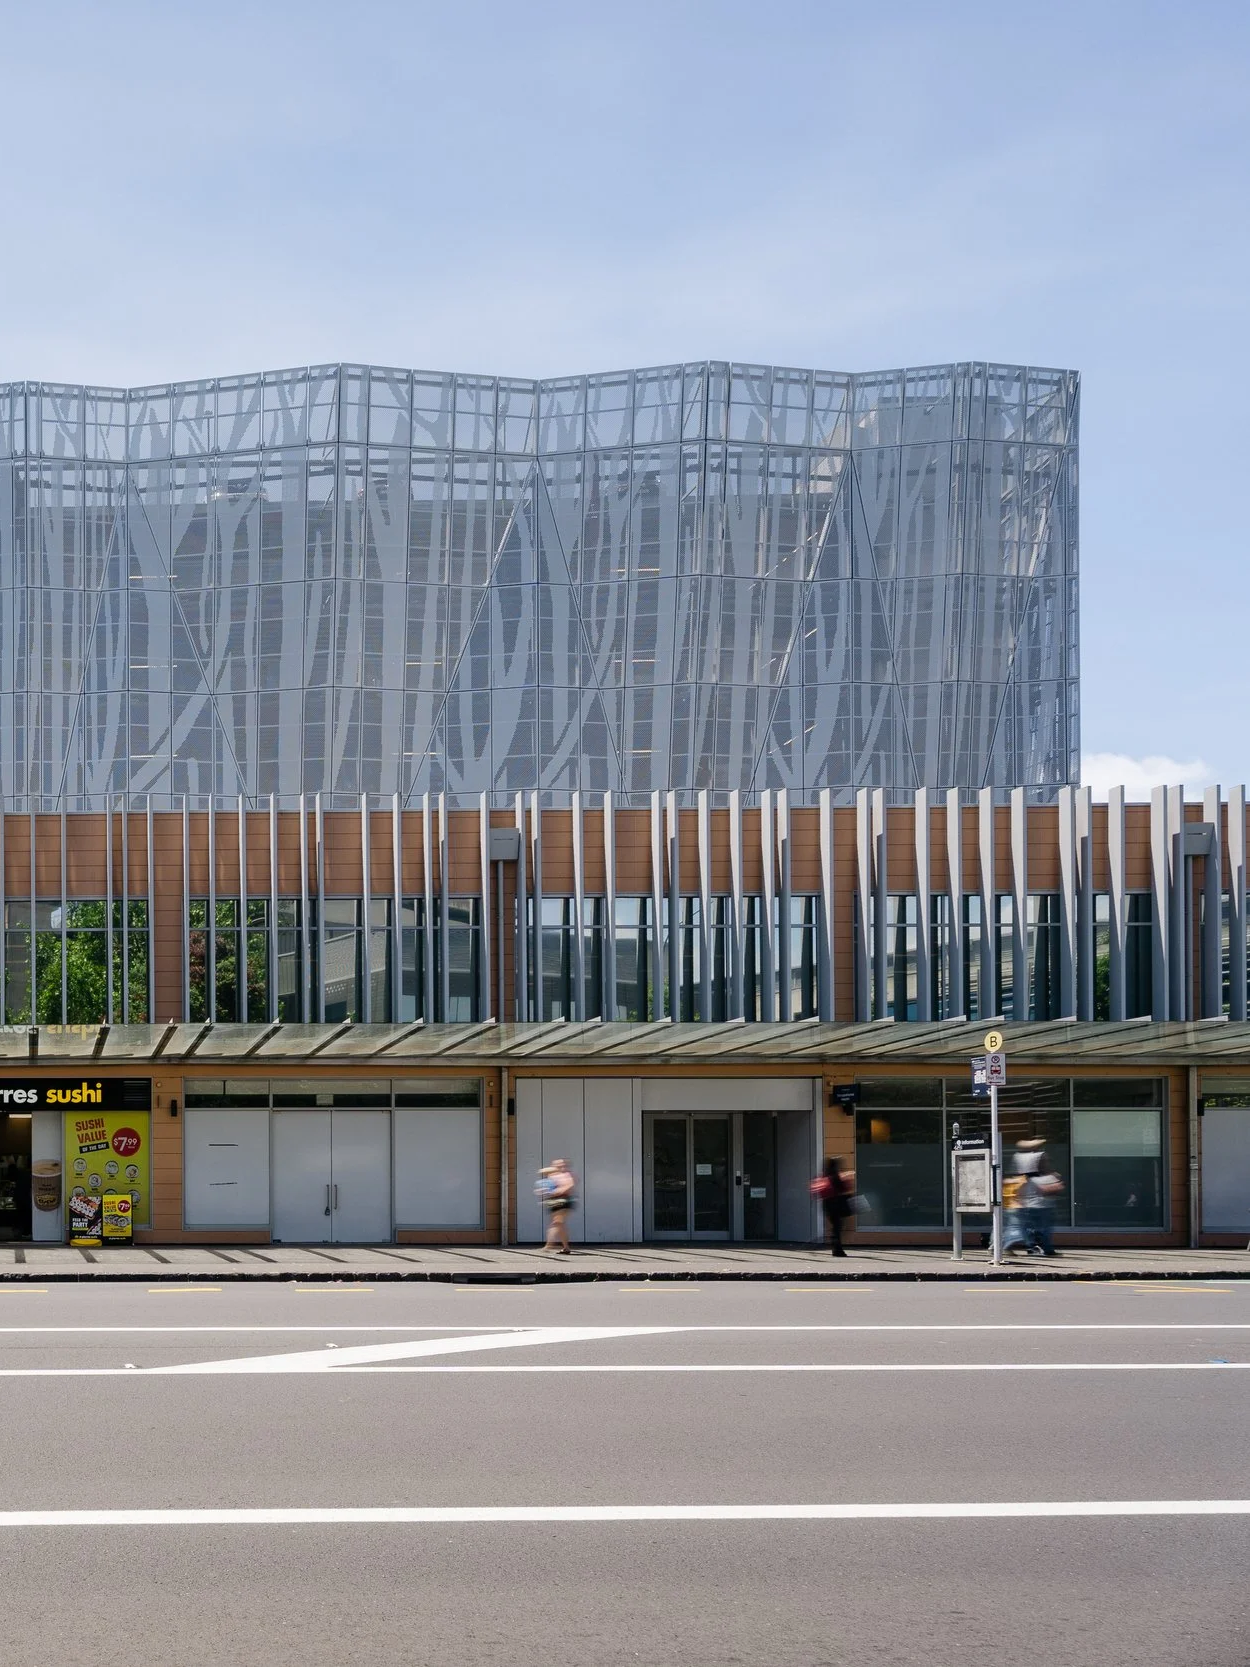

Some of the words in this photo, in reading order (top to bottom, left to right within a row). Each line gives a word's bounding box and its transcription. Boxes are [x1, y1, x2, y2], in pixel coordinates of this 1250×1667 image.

[990, 1036, 998, 1047] B
[46, 1082, 103, 1104] sushi
[75, 1117, 105, 1132] SUSHI
[77, 1130, 108, 1144] VALUE
[113, 1136, 138, 1151] $7.99
